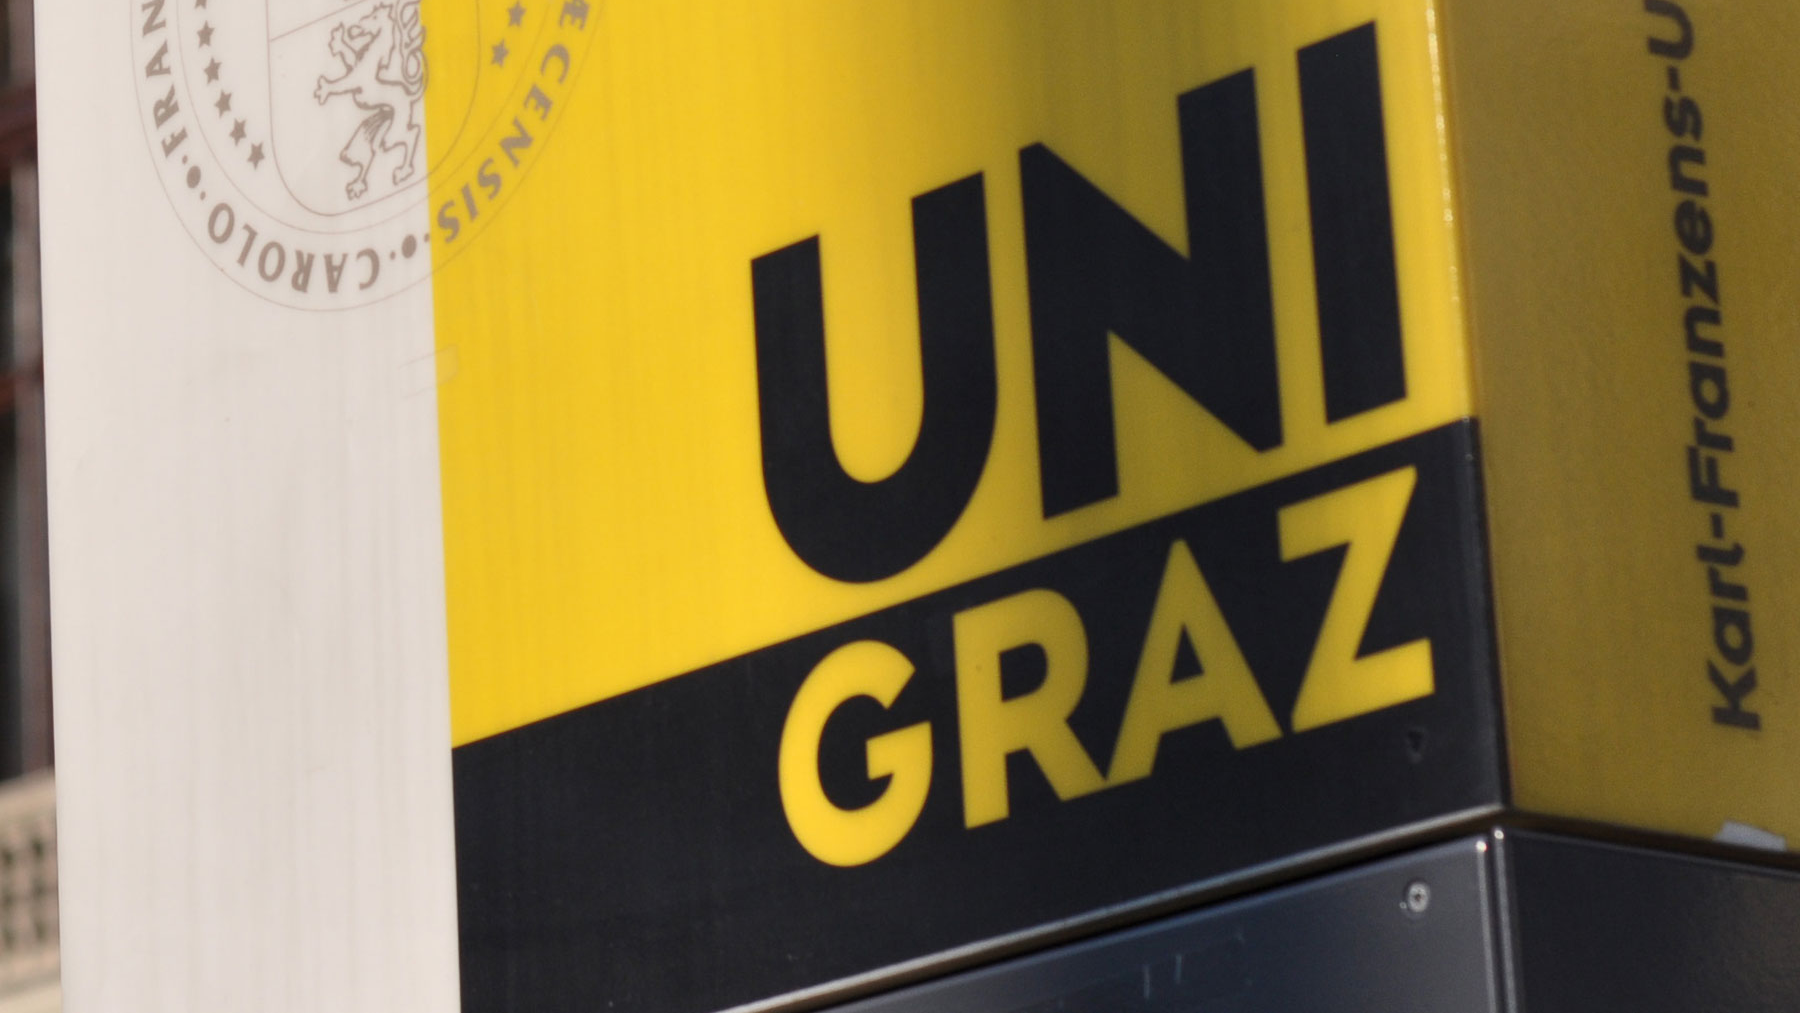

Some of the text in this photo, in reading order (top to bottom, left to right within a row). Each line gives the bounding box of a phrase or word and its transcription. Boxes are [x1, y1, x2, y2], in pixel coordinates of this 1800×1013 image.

[207, 200, 381, 294] CAROLO
[750, 20, 1407, 583] UNI
[779, 466, 1435, 866] GRAZ
